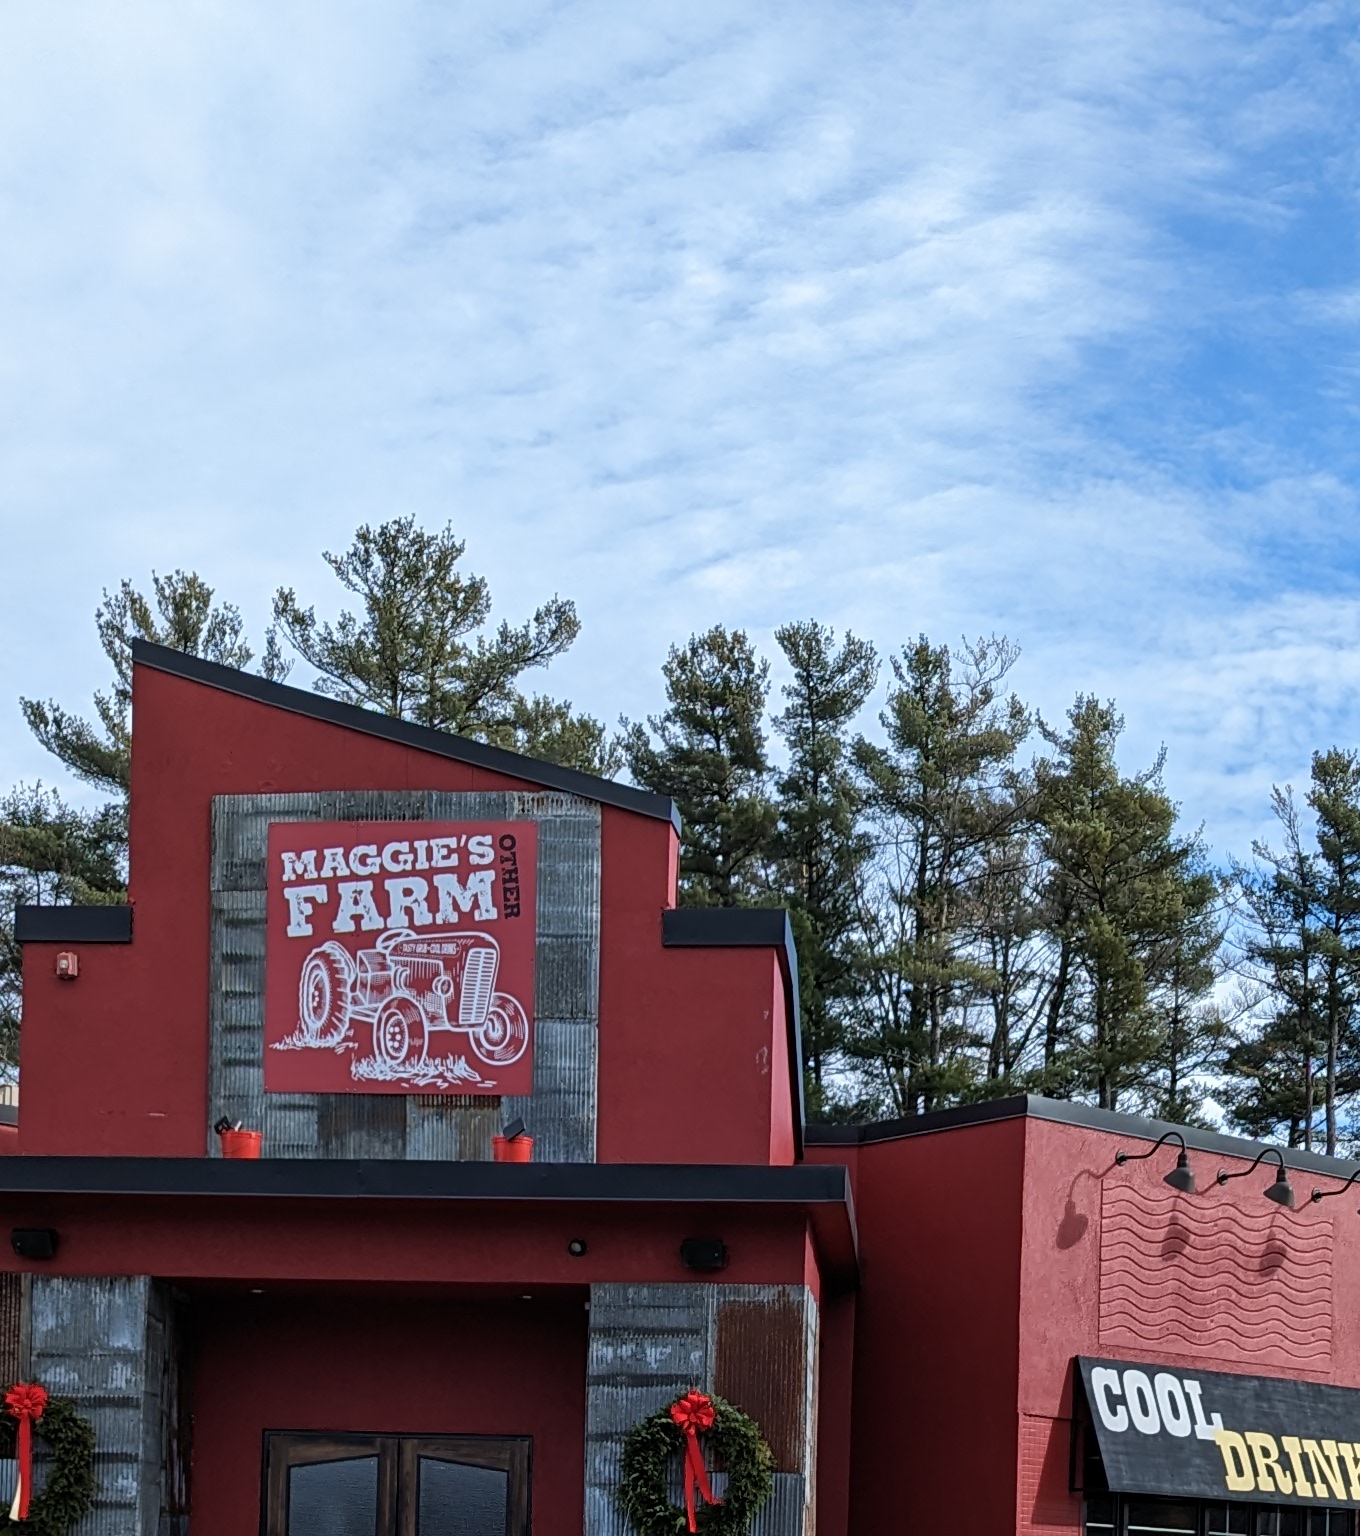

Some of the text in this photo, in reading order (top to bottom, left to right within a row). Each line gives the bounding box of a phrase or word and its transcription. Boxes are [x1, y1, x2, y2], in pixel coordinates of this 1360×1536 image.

[281, 834, 494, 881] MAGGIE'S
[498, 834, 520, 919] OTHER
[283, 870, 498, 937] FARM
[1091, 1366, 1224, 1440] COOL
